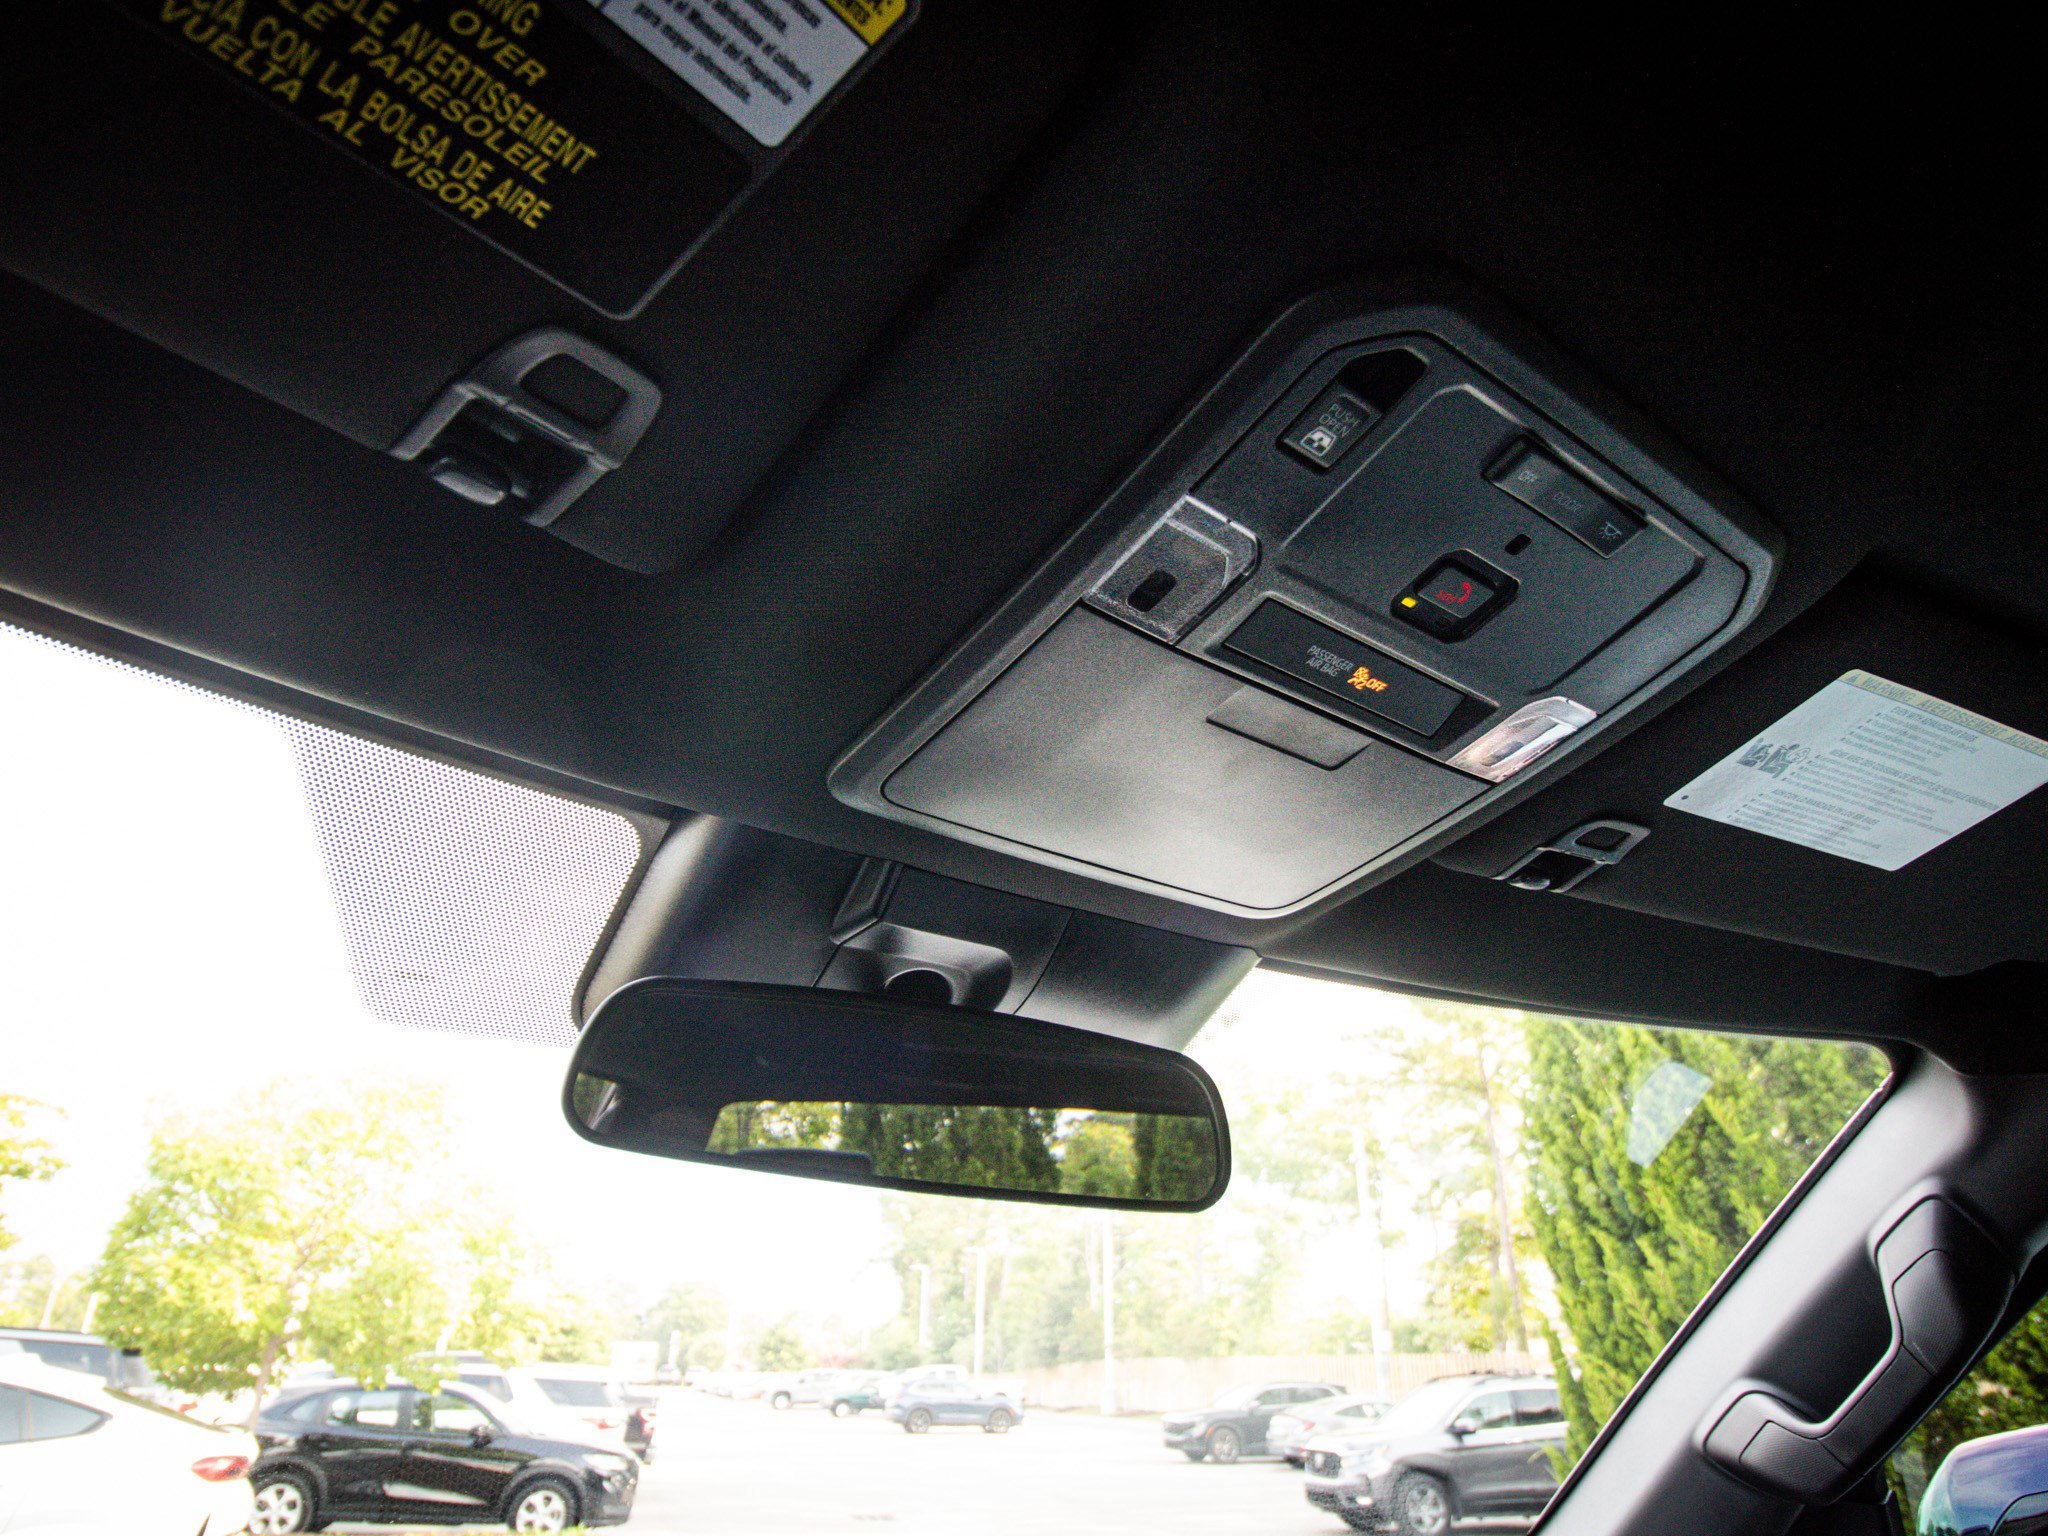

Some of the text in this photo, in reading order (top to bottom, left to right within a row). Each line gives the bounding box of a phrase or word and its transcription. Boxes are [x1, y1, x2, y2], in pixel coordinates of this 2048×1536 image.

[448, 9, 548, 87] OVER
[160, 0, 492, 221] VUELTA AL VISOR
[250, 15, 320, 78] CON
[317, 60, 361, 106] LA
[359, 89, 453, 167] BOLSA
[450, 149, 495, 192] DE
[486, 177, 553, 230] AIRE
[348, 34, 553, 185] PARESOLEIL
[392, 21, 597, 175] AVERTISSEMENT
[1305, 657, 1341, 677] AIR BAG
[1306, 645, 1354, 672] PASSENGER
[1365, 678, 1388, 692] OFF
[1862, 676, 1917, 701] WARNING
[1916, 699, 2008, 737] AVERTISSEMENT
